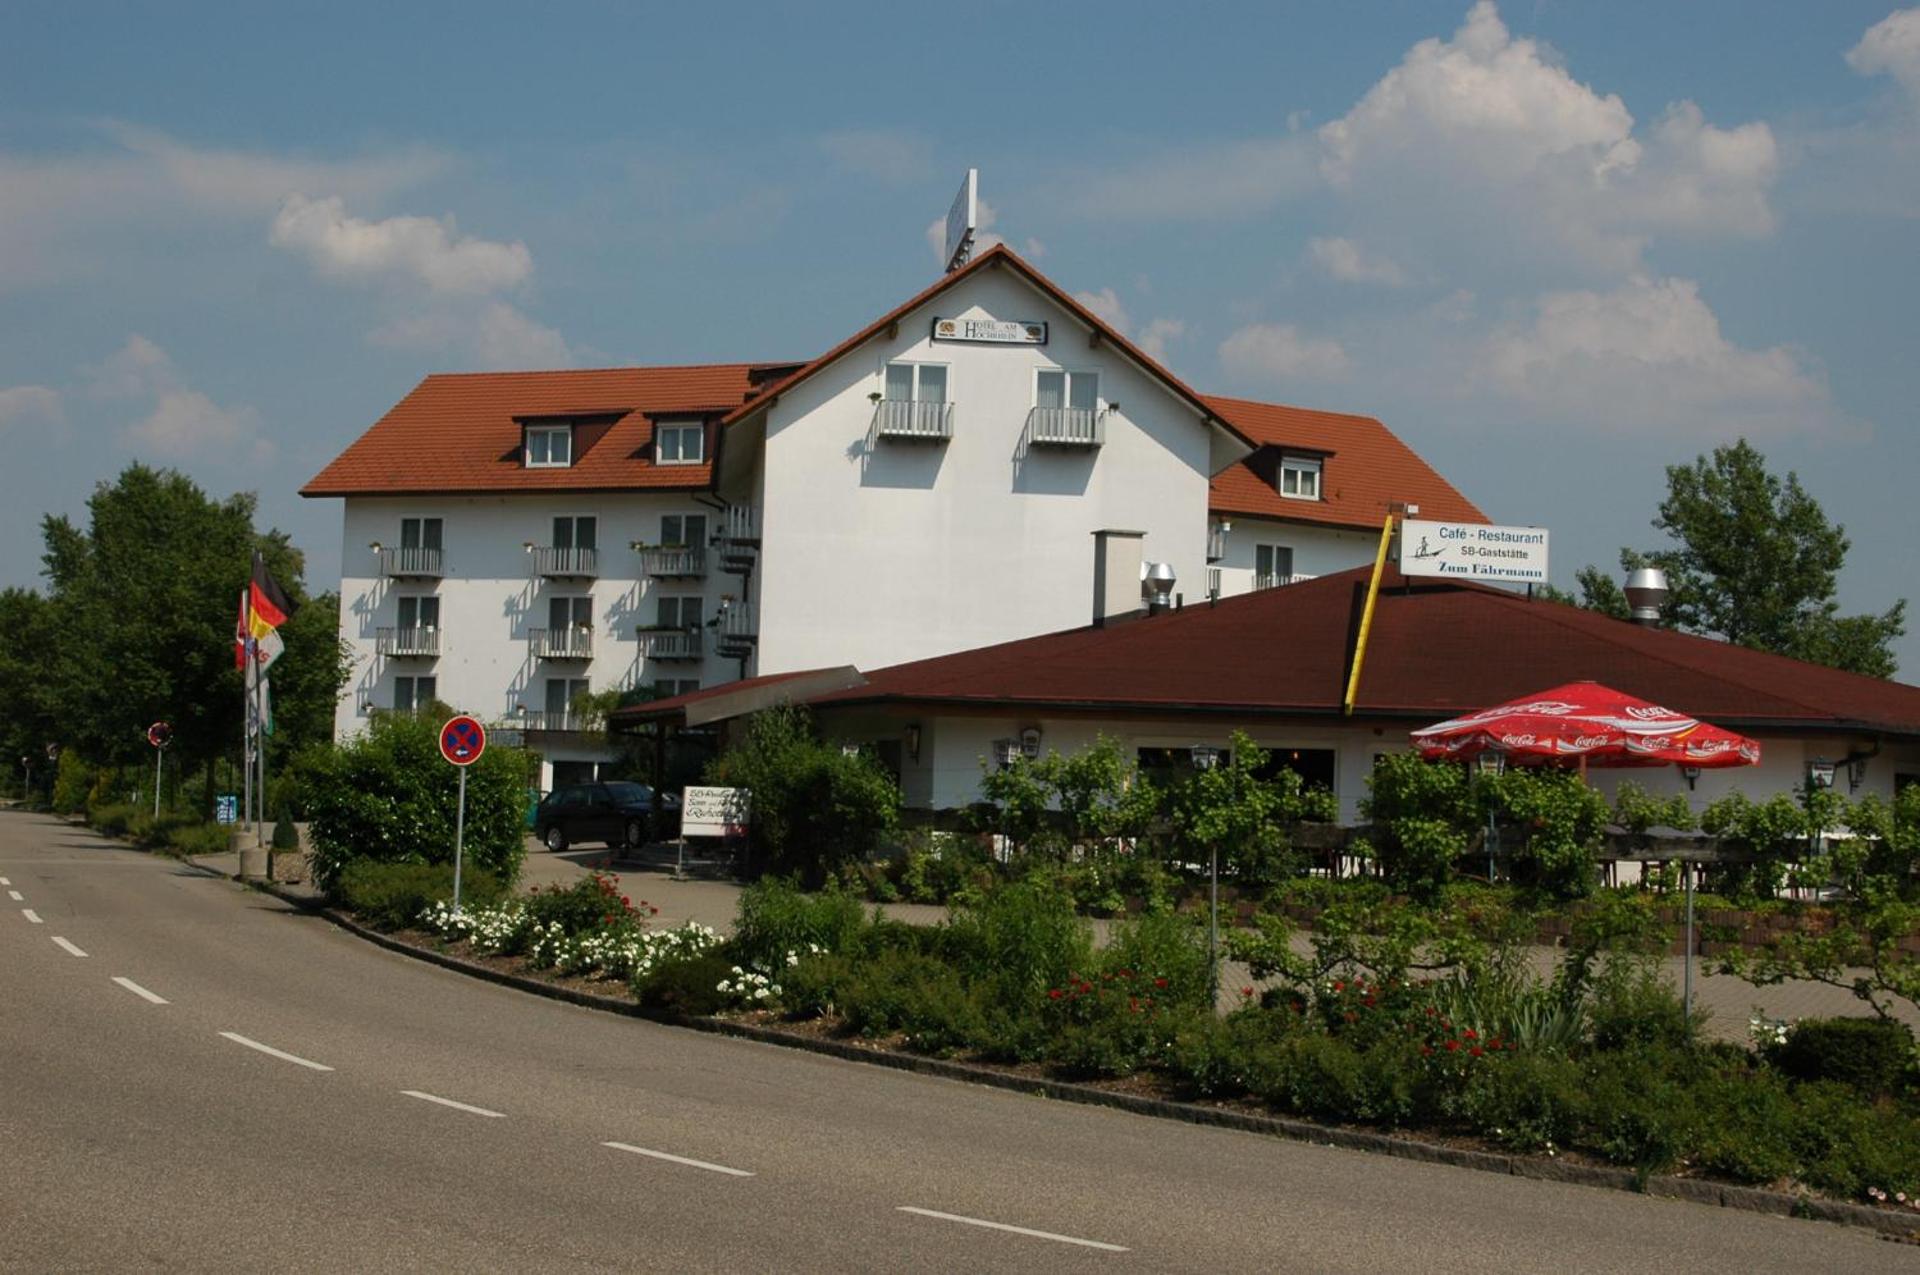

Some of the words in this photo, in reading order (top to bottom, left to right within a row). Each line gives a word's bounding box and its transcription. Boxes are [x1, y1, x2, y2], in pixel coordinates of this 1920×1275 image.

[1439, 526, 1467, 539] Café
[1478, 529, 1544, 544] Restaurant
[1439, 561, 1468, 573] Zum
[1472, 563, 1542, 578] Fährmann
